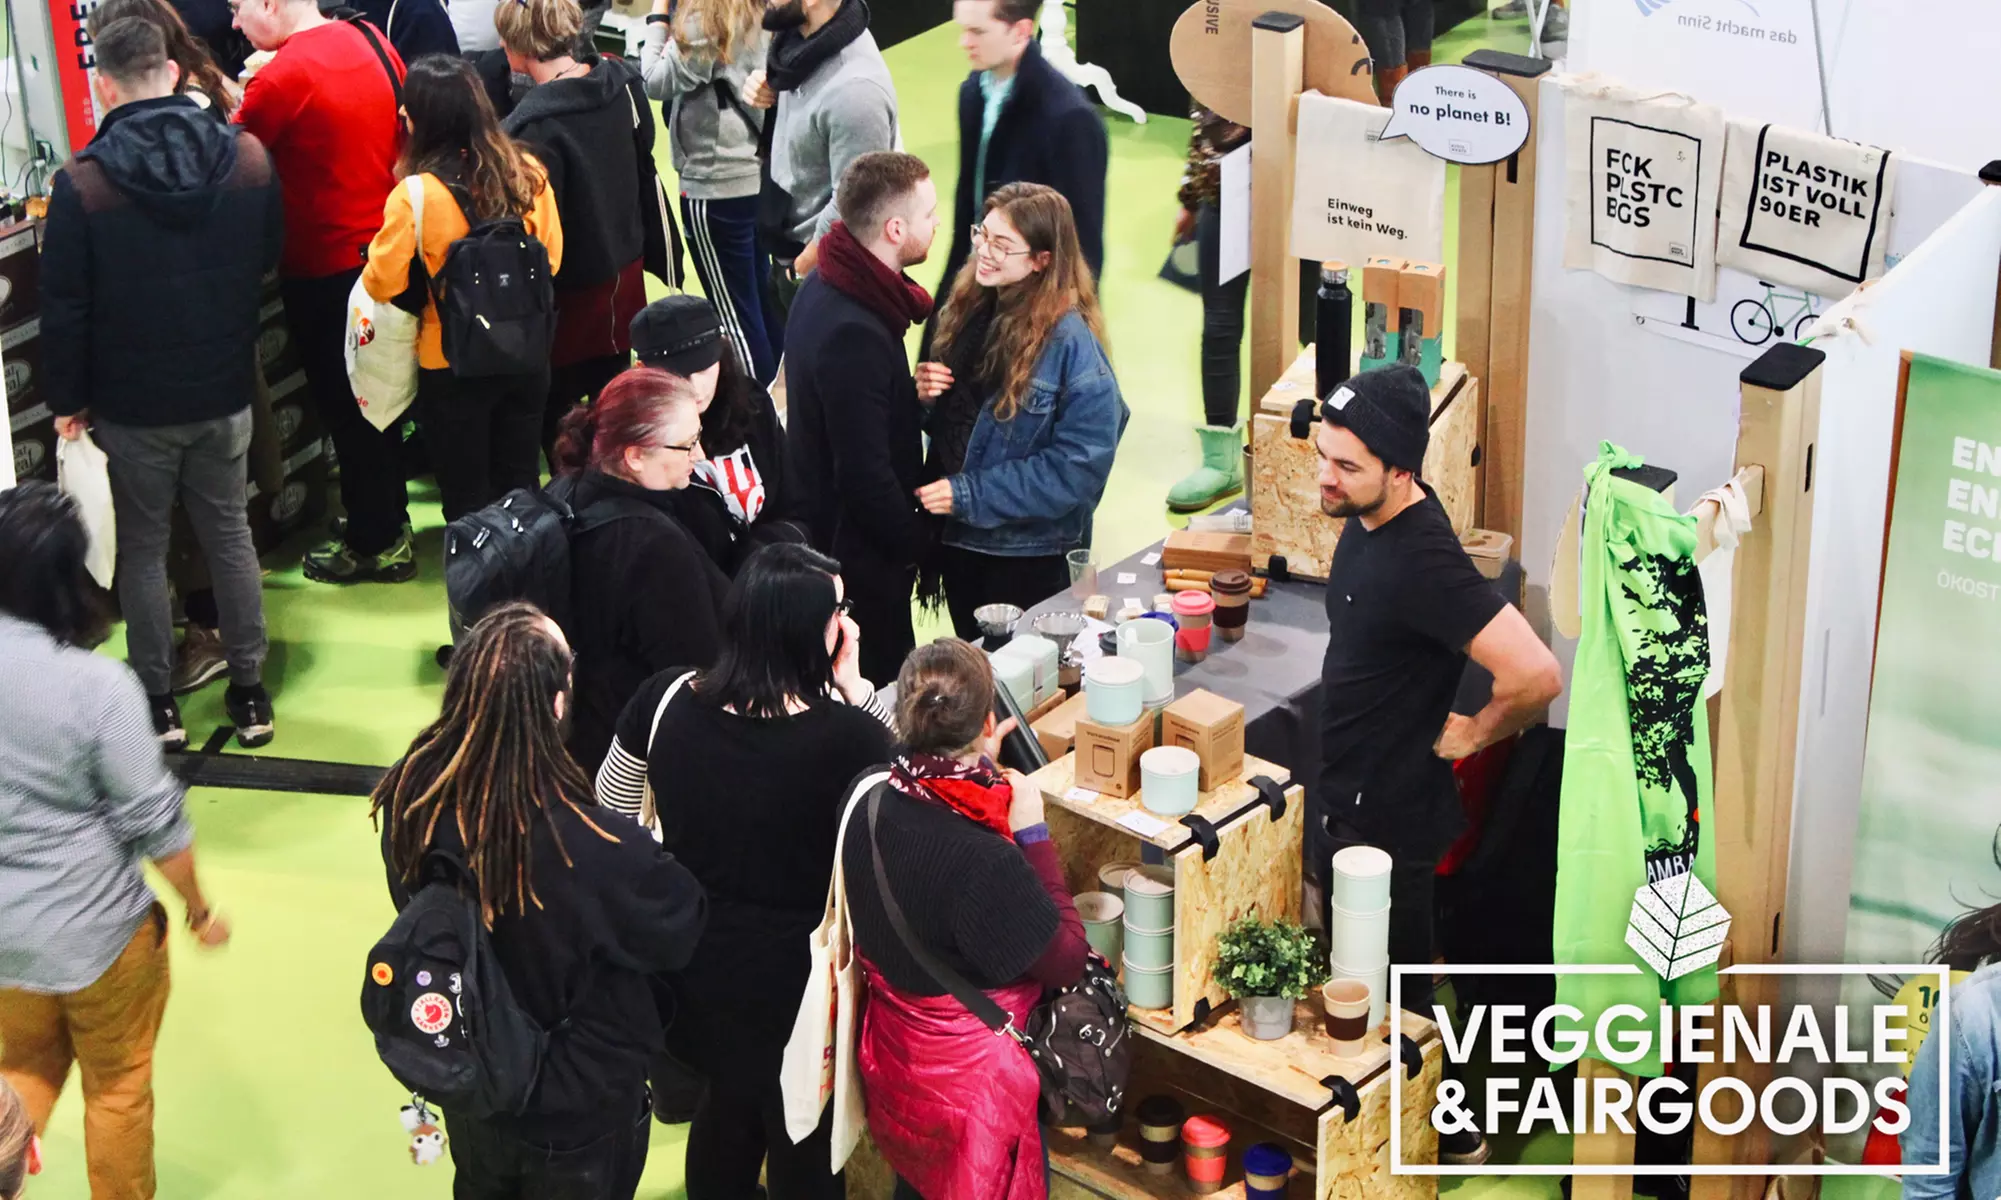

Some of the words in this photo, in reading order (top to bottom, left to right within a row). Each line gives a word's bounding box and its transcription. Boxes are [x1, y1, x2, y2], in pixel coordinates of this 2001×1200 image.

[1435, 86, 1464, 99] There
[1467, 89, 1477, 100] is
[1410, 103, 1430, 116] no
[1436, 103, 1489, 123] planet
[1495, 111, 1511, 126] B!
[1606, 148, 1653, 179] FCK
[1765, 150, 1868, 197] PLASTIK
[1606, 172, 1683, 208] PLSTC
[1763, 173, 1800, 197] IST
[1806, 186, 1866, 220] VOLL
[1327, 198, 1373, 219] Einweg
[1606, 196, 1651, 228] BGS
[1760, 195, 1821, 228] 90ER
[1327, 212, 1344, 225] ist
[1347, 216, 1372, 231] kein
[1376, 222, 1408, 240] Weg.
